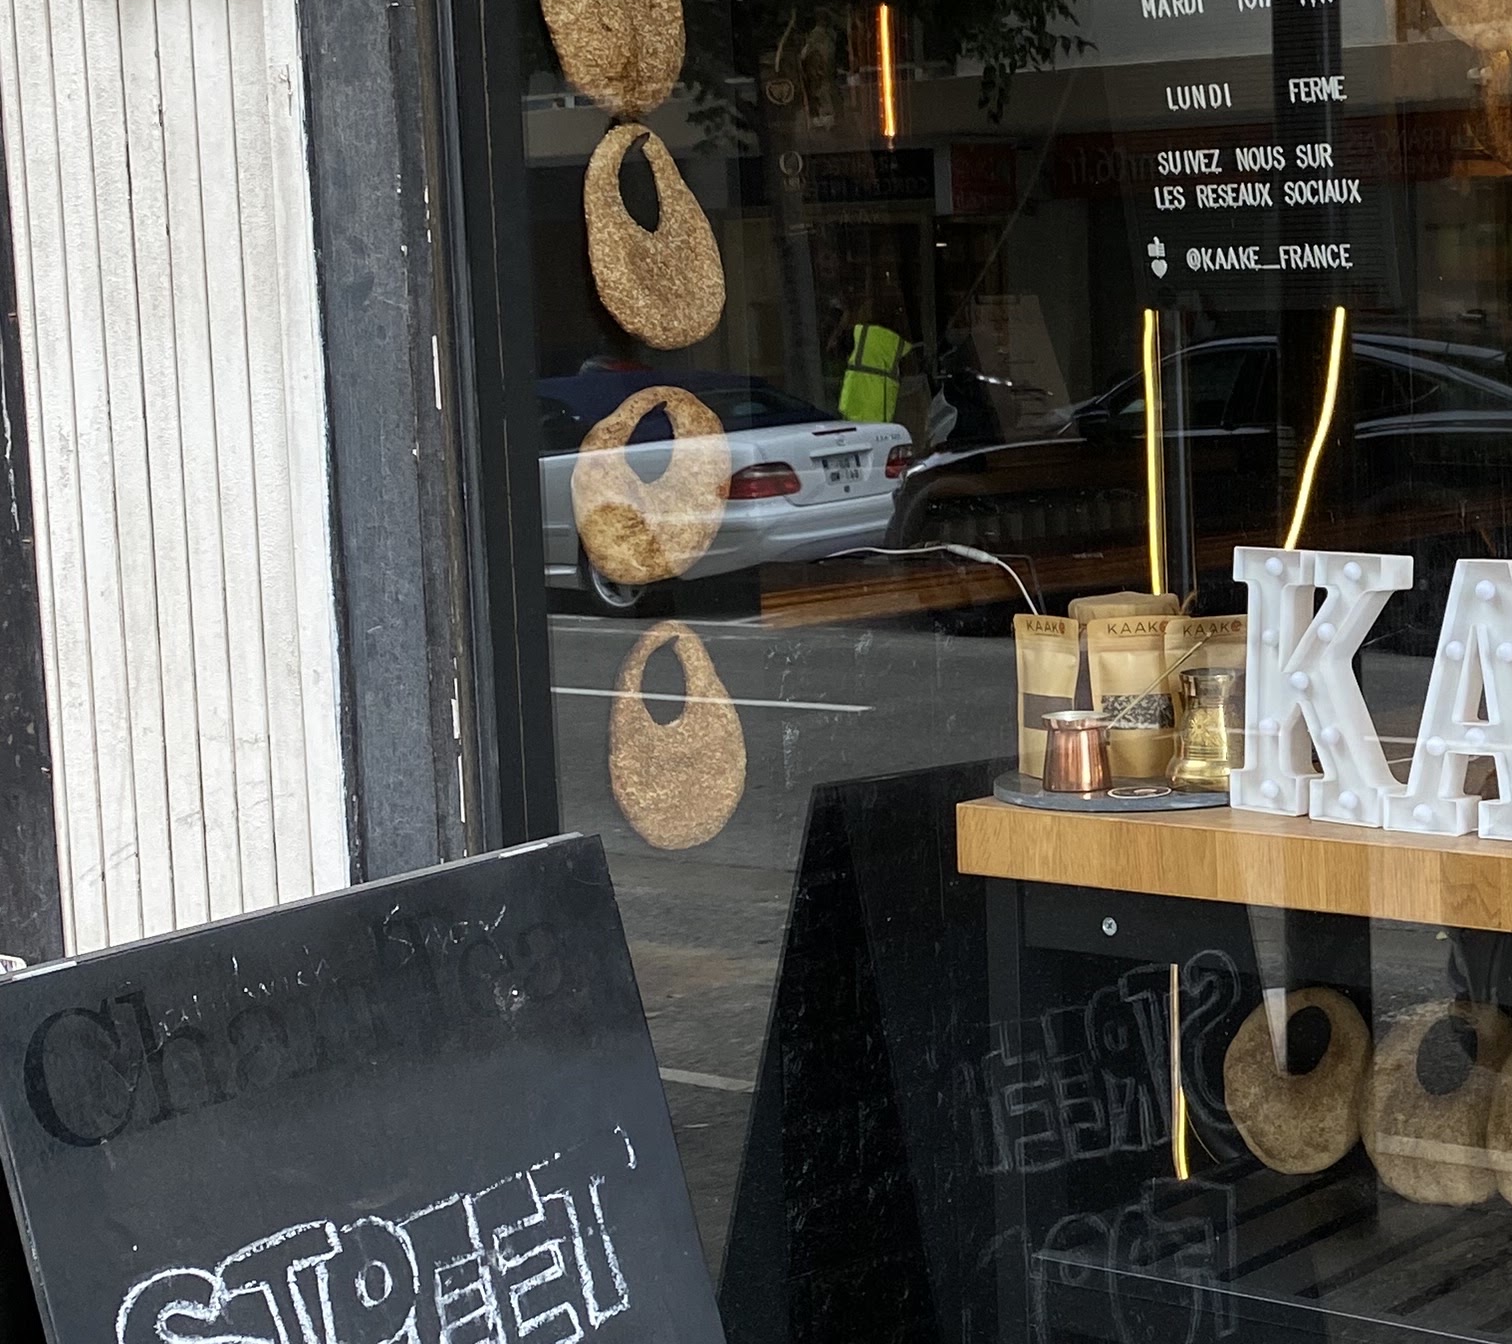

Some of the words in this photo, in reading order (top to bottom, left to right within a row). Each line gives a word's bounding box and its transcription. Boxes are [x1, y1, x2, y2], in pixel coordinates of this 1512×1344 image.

[1166, 82, 1232, 111] LUNDI
[1289, 75, 1348, 104] FERME
[1157, 149, 1223, 176] SUIVEZ
[1235, 146, 1286, 173] NOUS
[1295, 143, 1335, 169] SUR
[1154, 184, 1186, 212] LES
[1195, 181, 1273, 209] RESEAUX
[1284, 179, 1362, 205] SOCIAUX
[1186, 243, 1353, 272] @KAAKE_FRANCE
